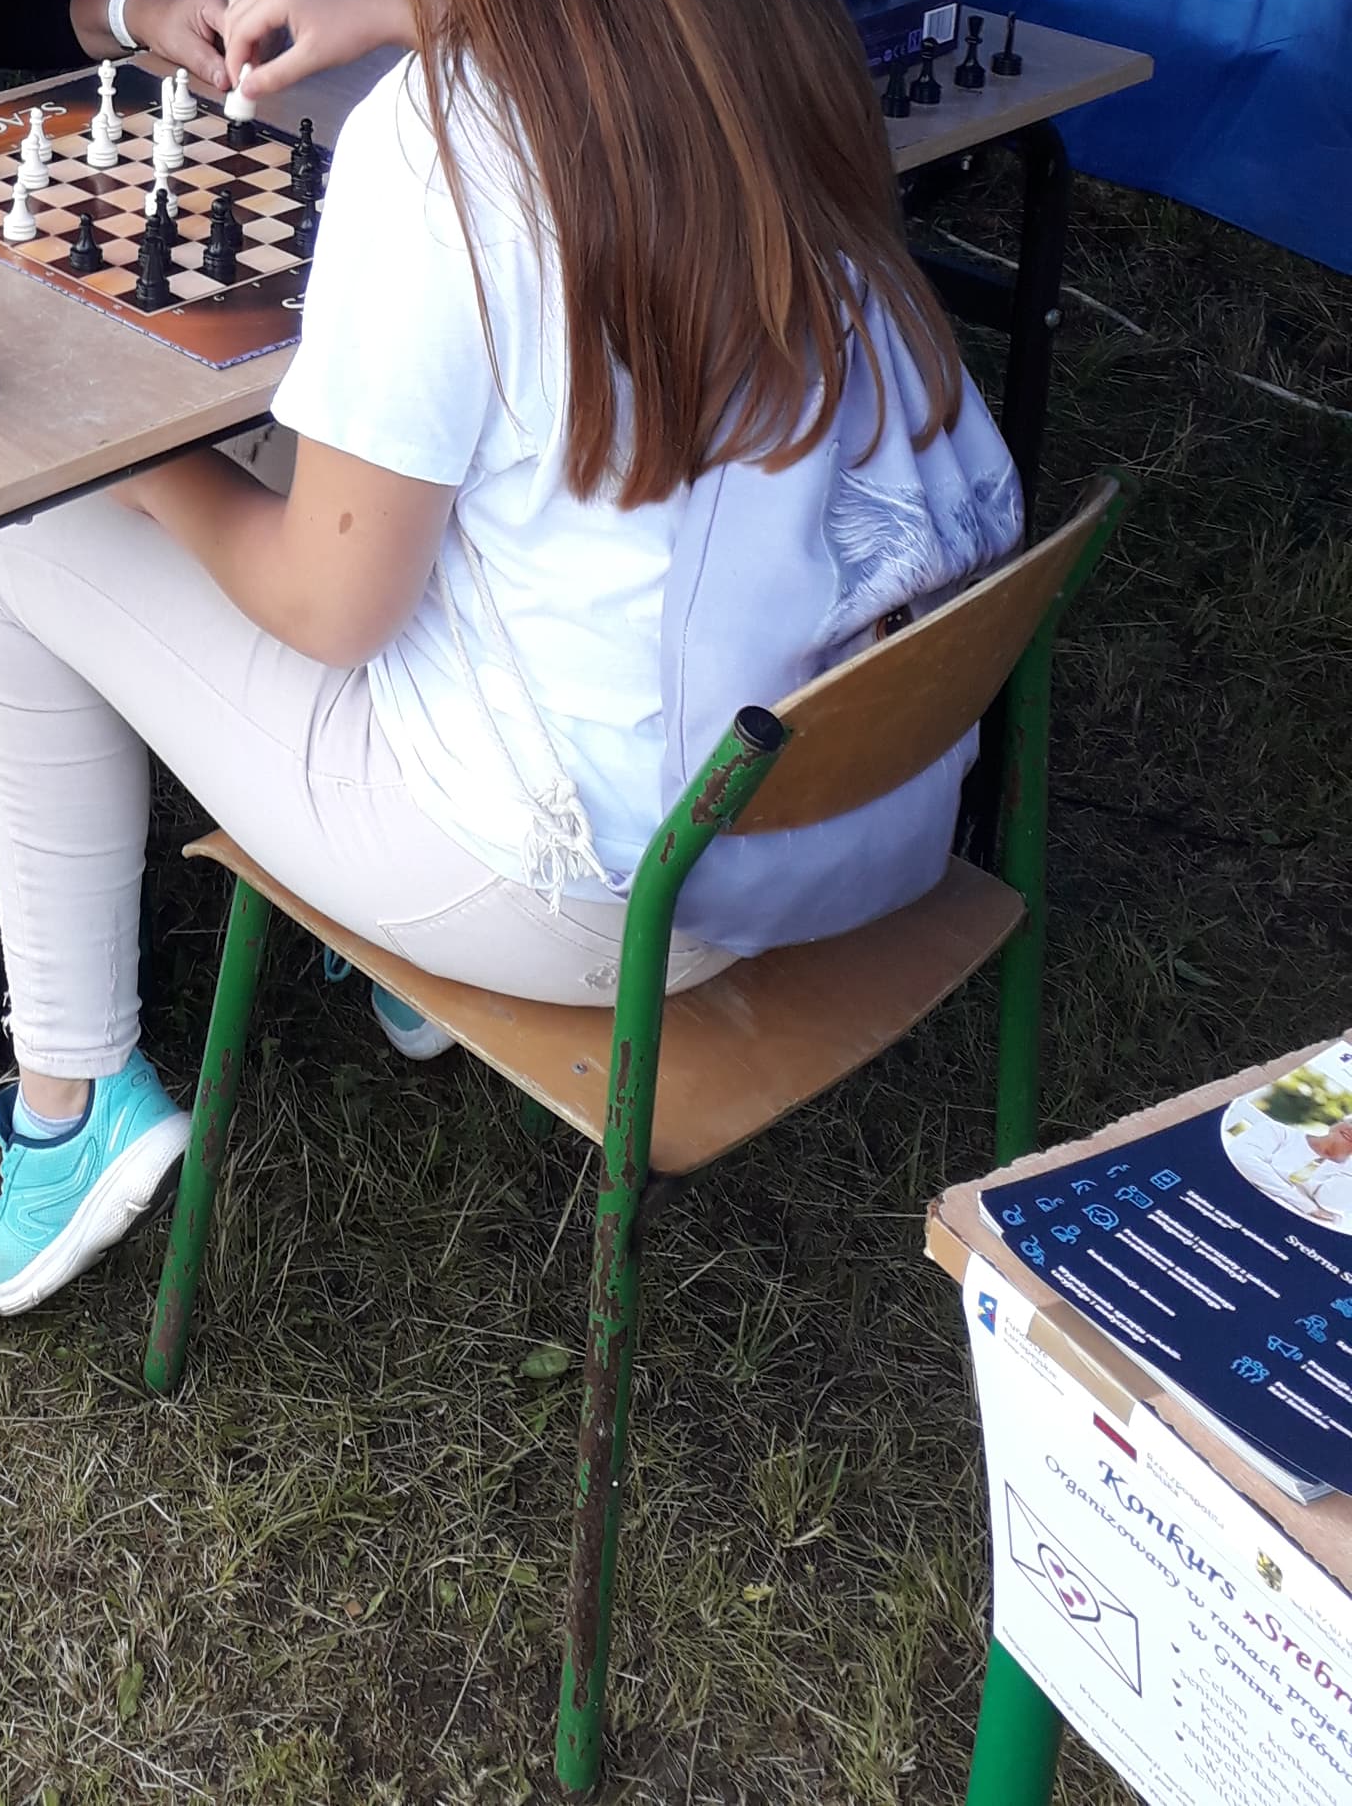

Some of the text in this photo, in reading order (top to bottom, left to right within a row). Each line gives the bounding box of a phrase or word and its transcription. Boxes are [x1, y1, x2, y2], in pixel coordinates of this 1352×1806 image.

[1284, 1235, 1340, 1274] Srebrna
[1098, 1459, 1238, 1601] Konkurs
[1045, 1454, 1181, 1588] Organizowany
[1185, 1586, 1205, 1608] w
[1211, 1610, 1282, 1684] ramach
[1179, 1668, 1249, 1736] seniorów
[1188, 1620, 1208, 1641] w
[1214, 1644, 1284, 1715] Gminie
[1199, 1668, 1248, 1720] Celem
[1201, 1702, 1264, 1769] Konkurs
[1201, 1720, 1282, 1804] Kandydaci
